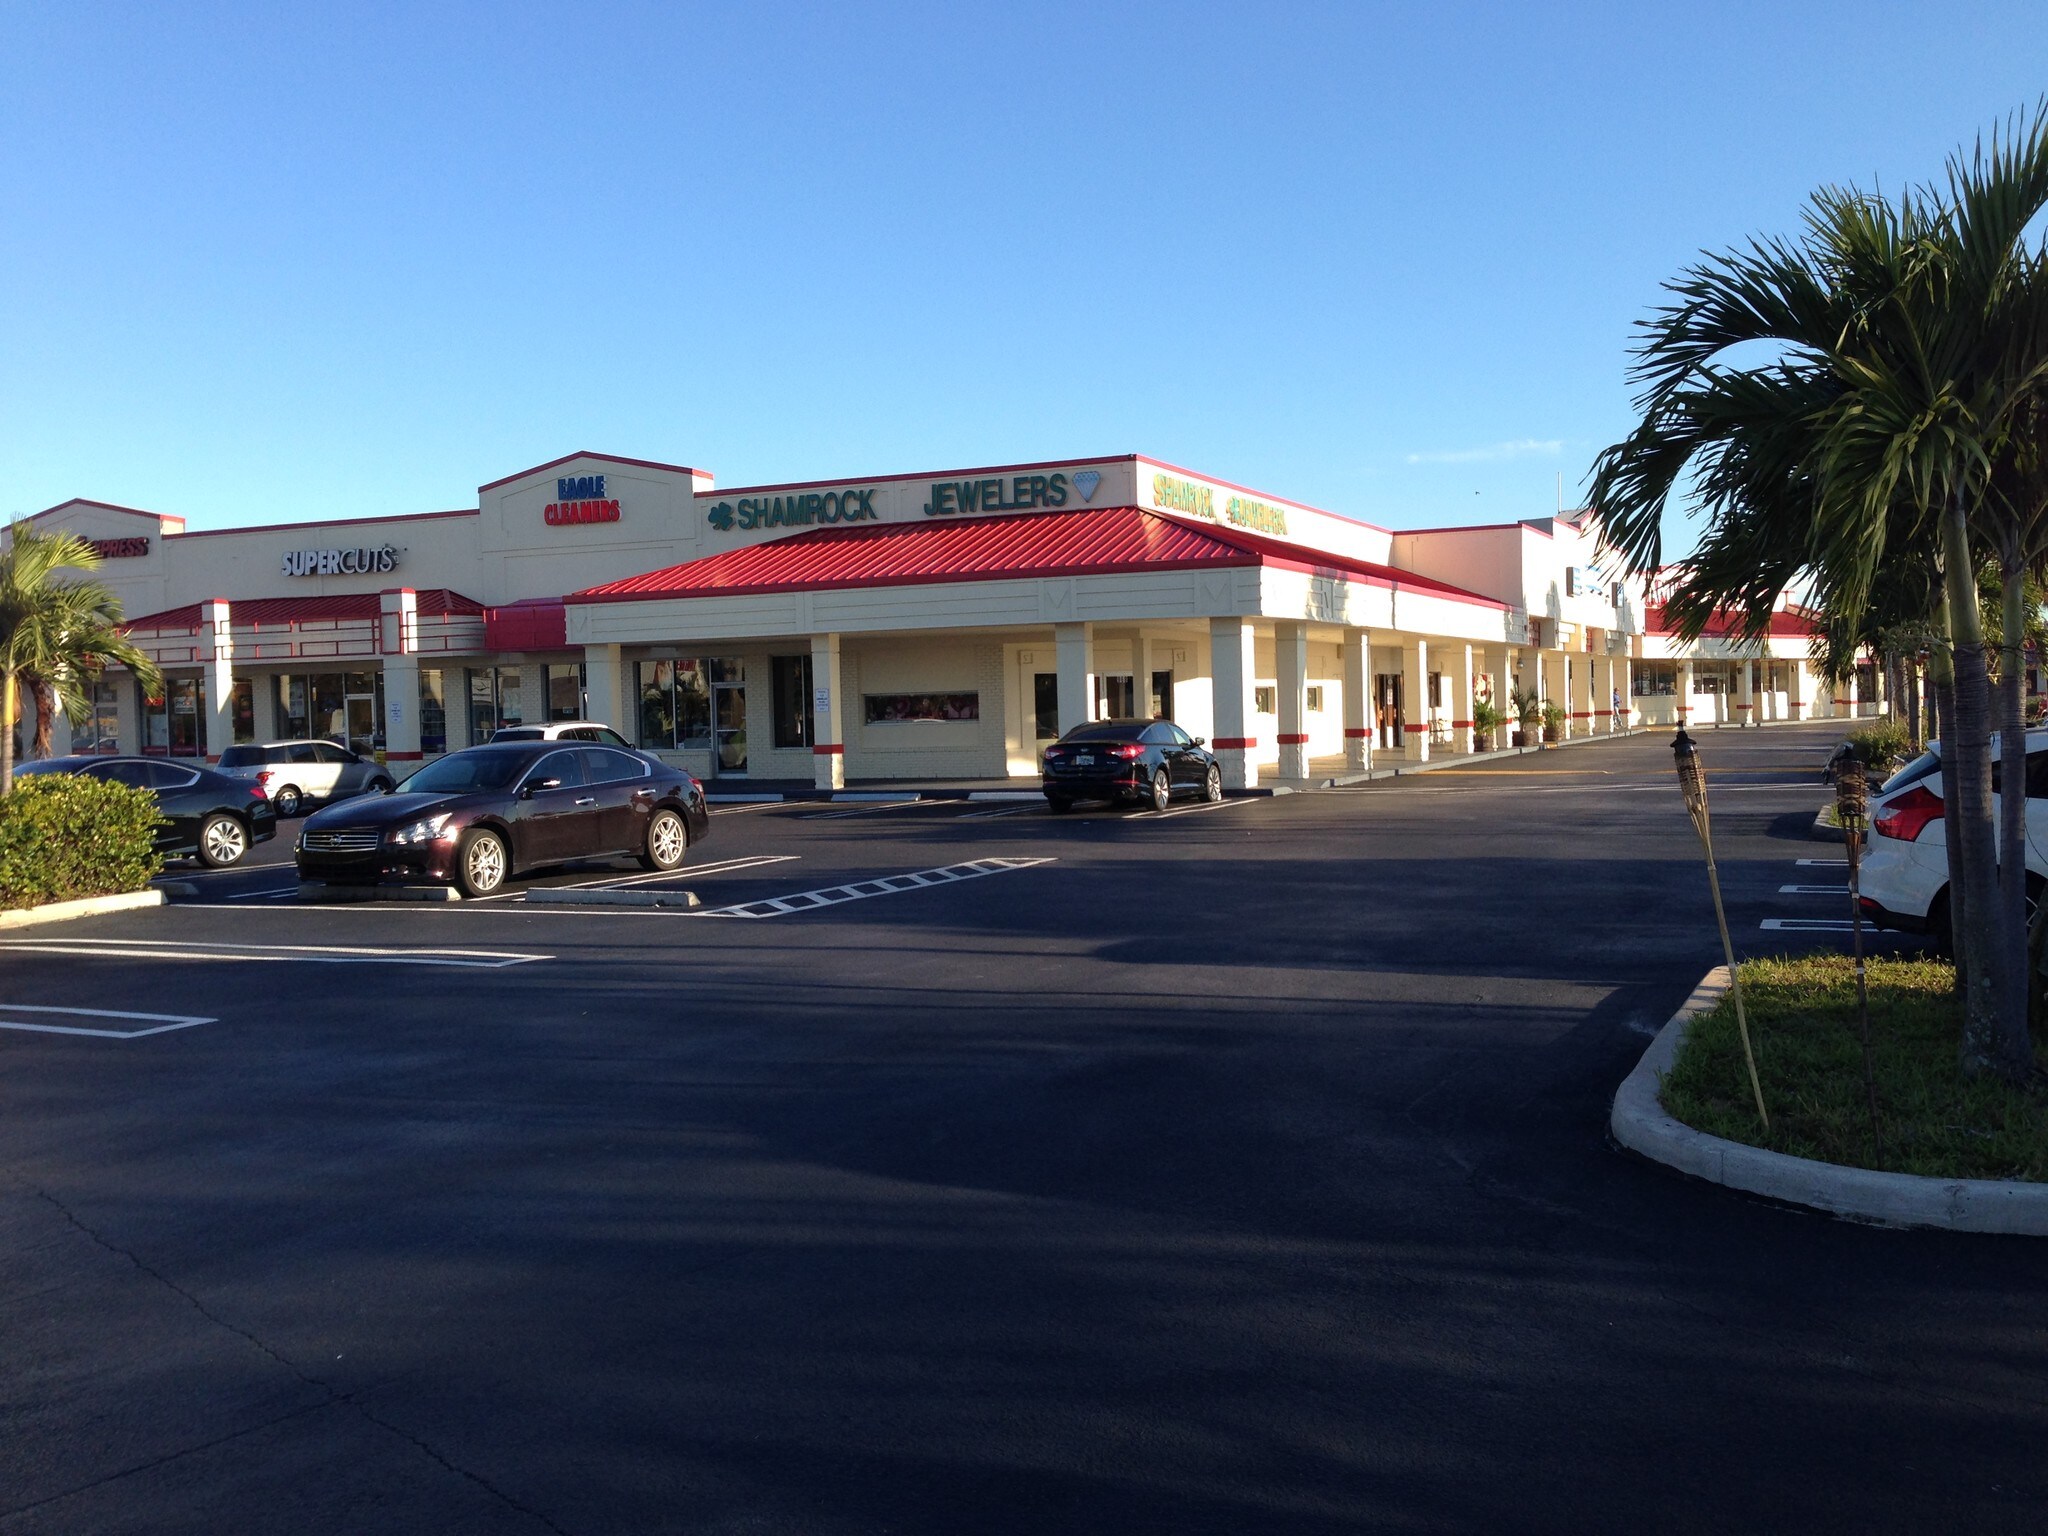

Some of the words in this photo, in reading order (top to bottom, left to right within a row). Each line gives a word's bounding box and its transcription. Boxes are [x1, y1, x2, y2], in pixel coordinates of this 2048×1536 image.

[557, 475, 607, 501] EAGLE
[738, 489, 878, 529] SHAMROCK
[924, 473, 1068, 516] JEWELERS
[544, 499, 621, 526] CLEANERS
[281, 547, 394, 577] SUPERCUTS
